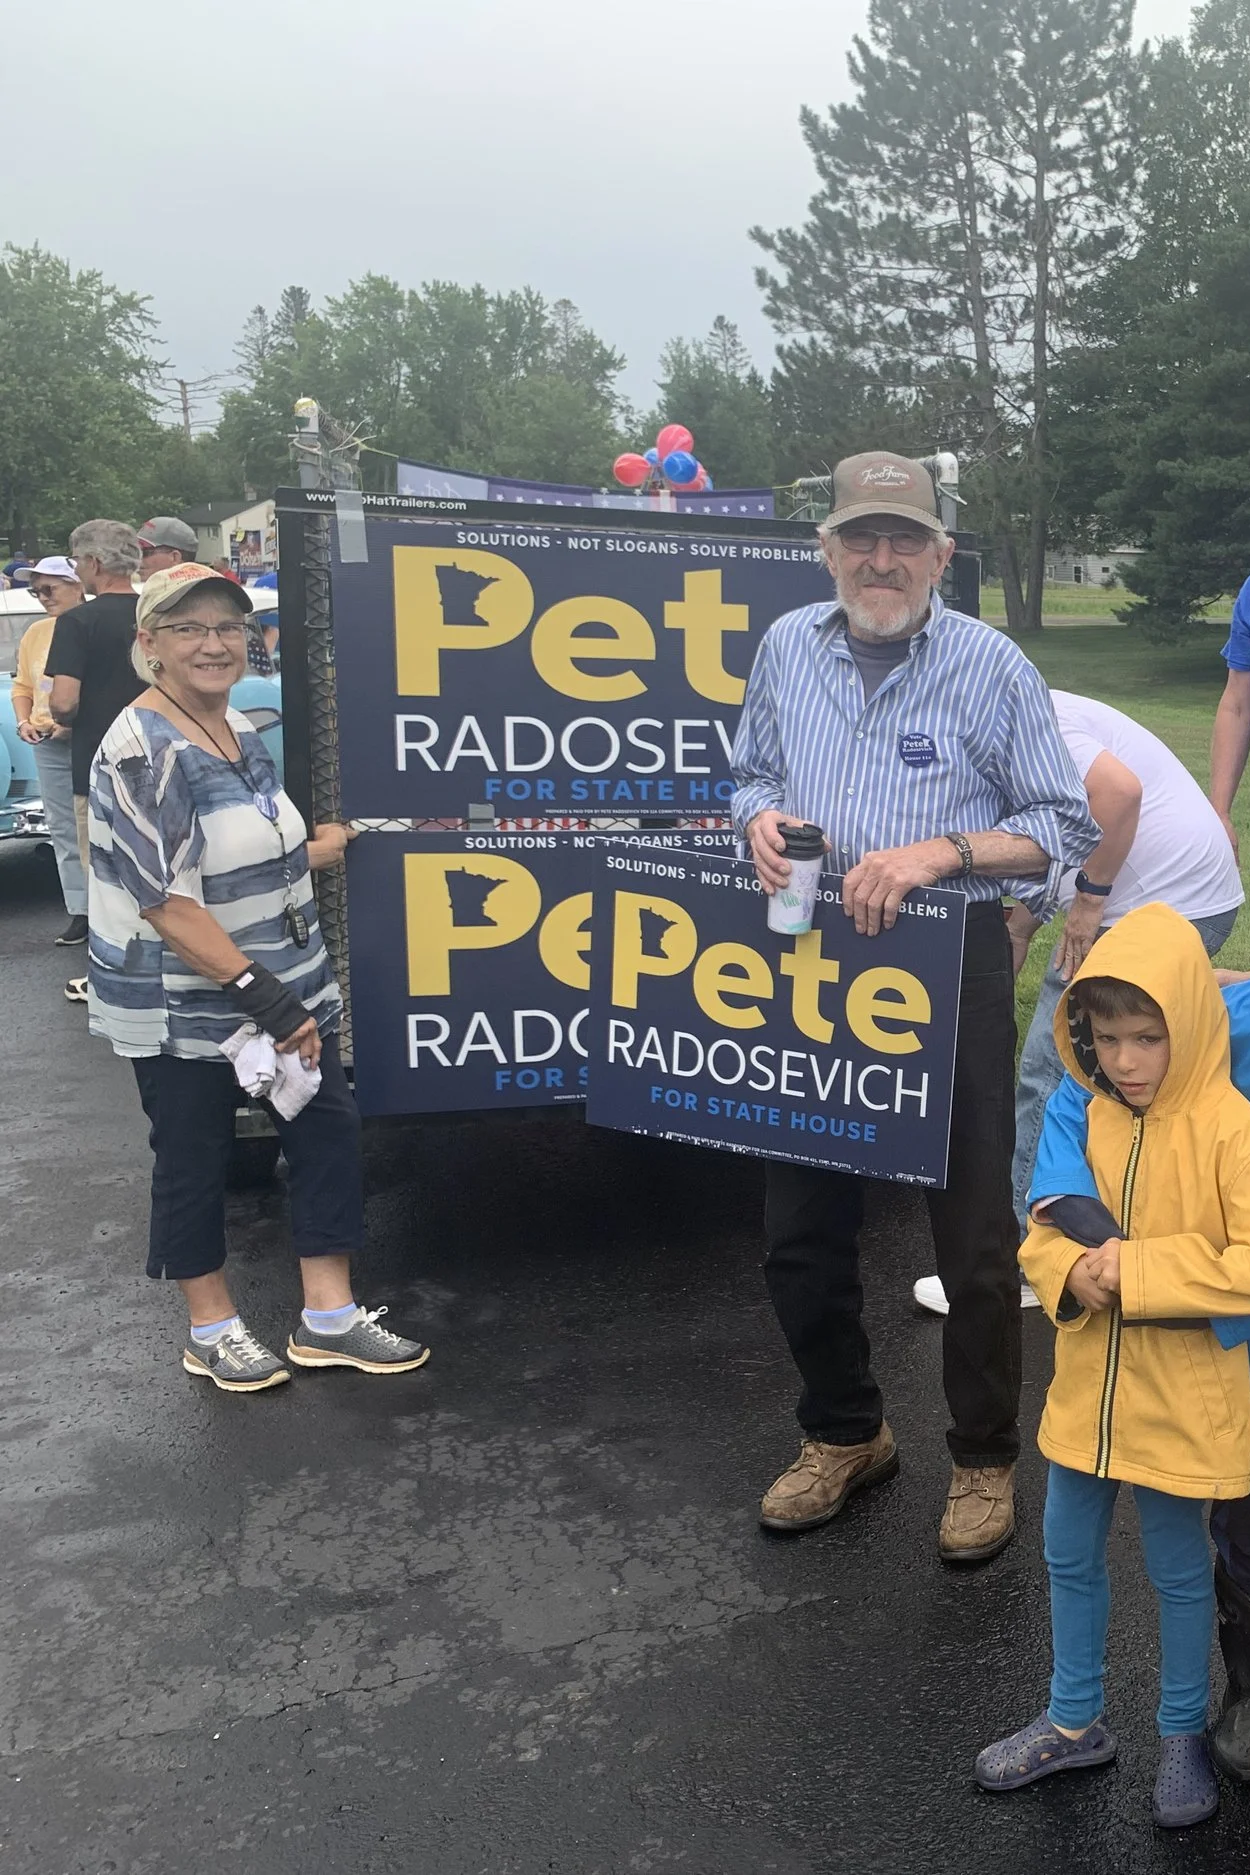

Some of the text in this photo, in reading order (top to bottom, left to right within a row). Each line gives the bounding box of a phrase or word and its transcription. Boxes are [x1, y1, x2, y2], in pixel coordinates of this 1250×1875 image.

[306, 493, 466, 510] wwwHatTrailers.com
[457, 531, 550, 548] SOLUTIONS
[568, 538, 600, 551] NOT
[606, 539, 684, 556] SLOGANS-
[691, 544, 738, 558] SOLVE
[743, 548, 820, 562] PROBLEMS
[393, 545, 749, 705] Pet
[394, 713, 737, 774] RADOSE
[485, 778, 556, 800] FOR
[570, 779, 674, 801] STATE
[465, 836, 557, 849] SOLUTIONS
[574, 836, 595, 848] NO
[694, 836, 738, 846] SOLVE
[607, 856, 686, 880] SOLUTIONS
[701, 872, 730, 888] NOT
[899, 902, 948, 920] BLEMS
[404, 853, 592, 996] Pe
[612, 890, 932, 1054] Pete
[496, 1067, 564, 1090] FOR
[608, 1018, 928, 1118] RADOSEVICH
[650, 1086, 877, 1143] FOR STATE HOUSE
